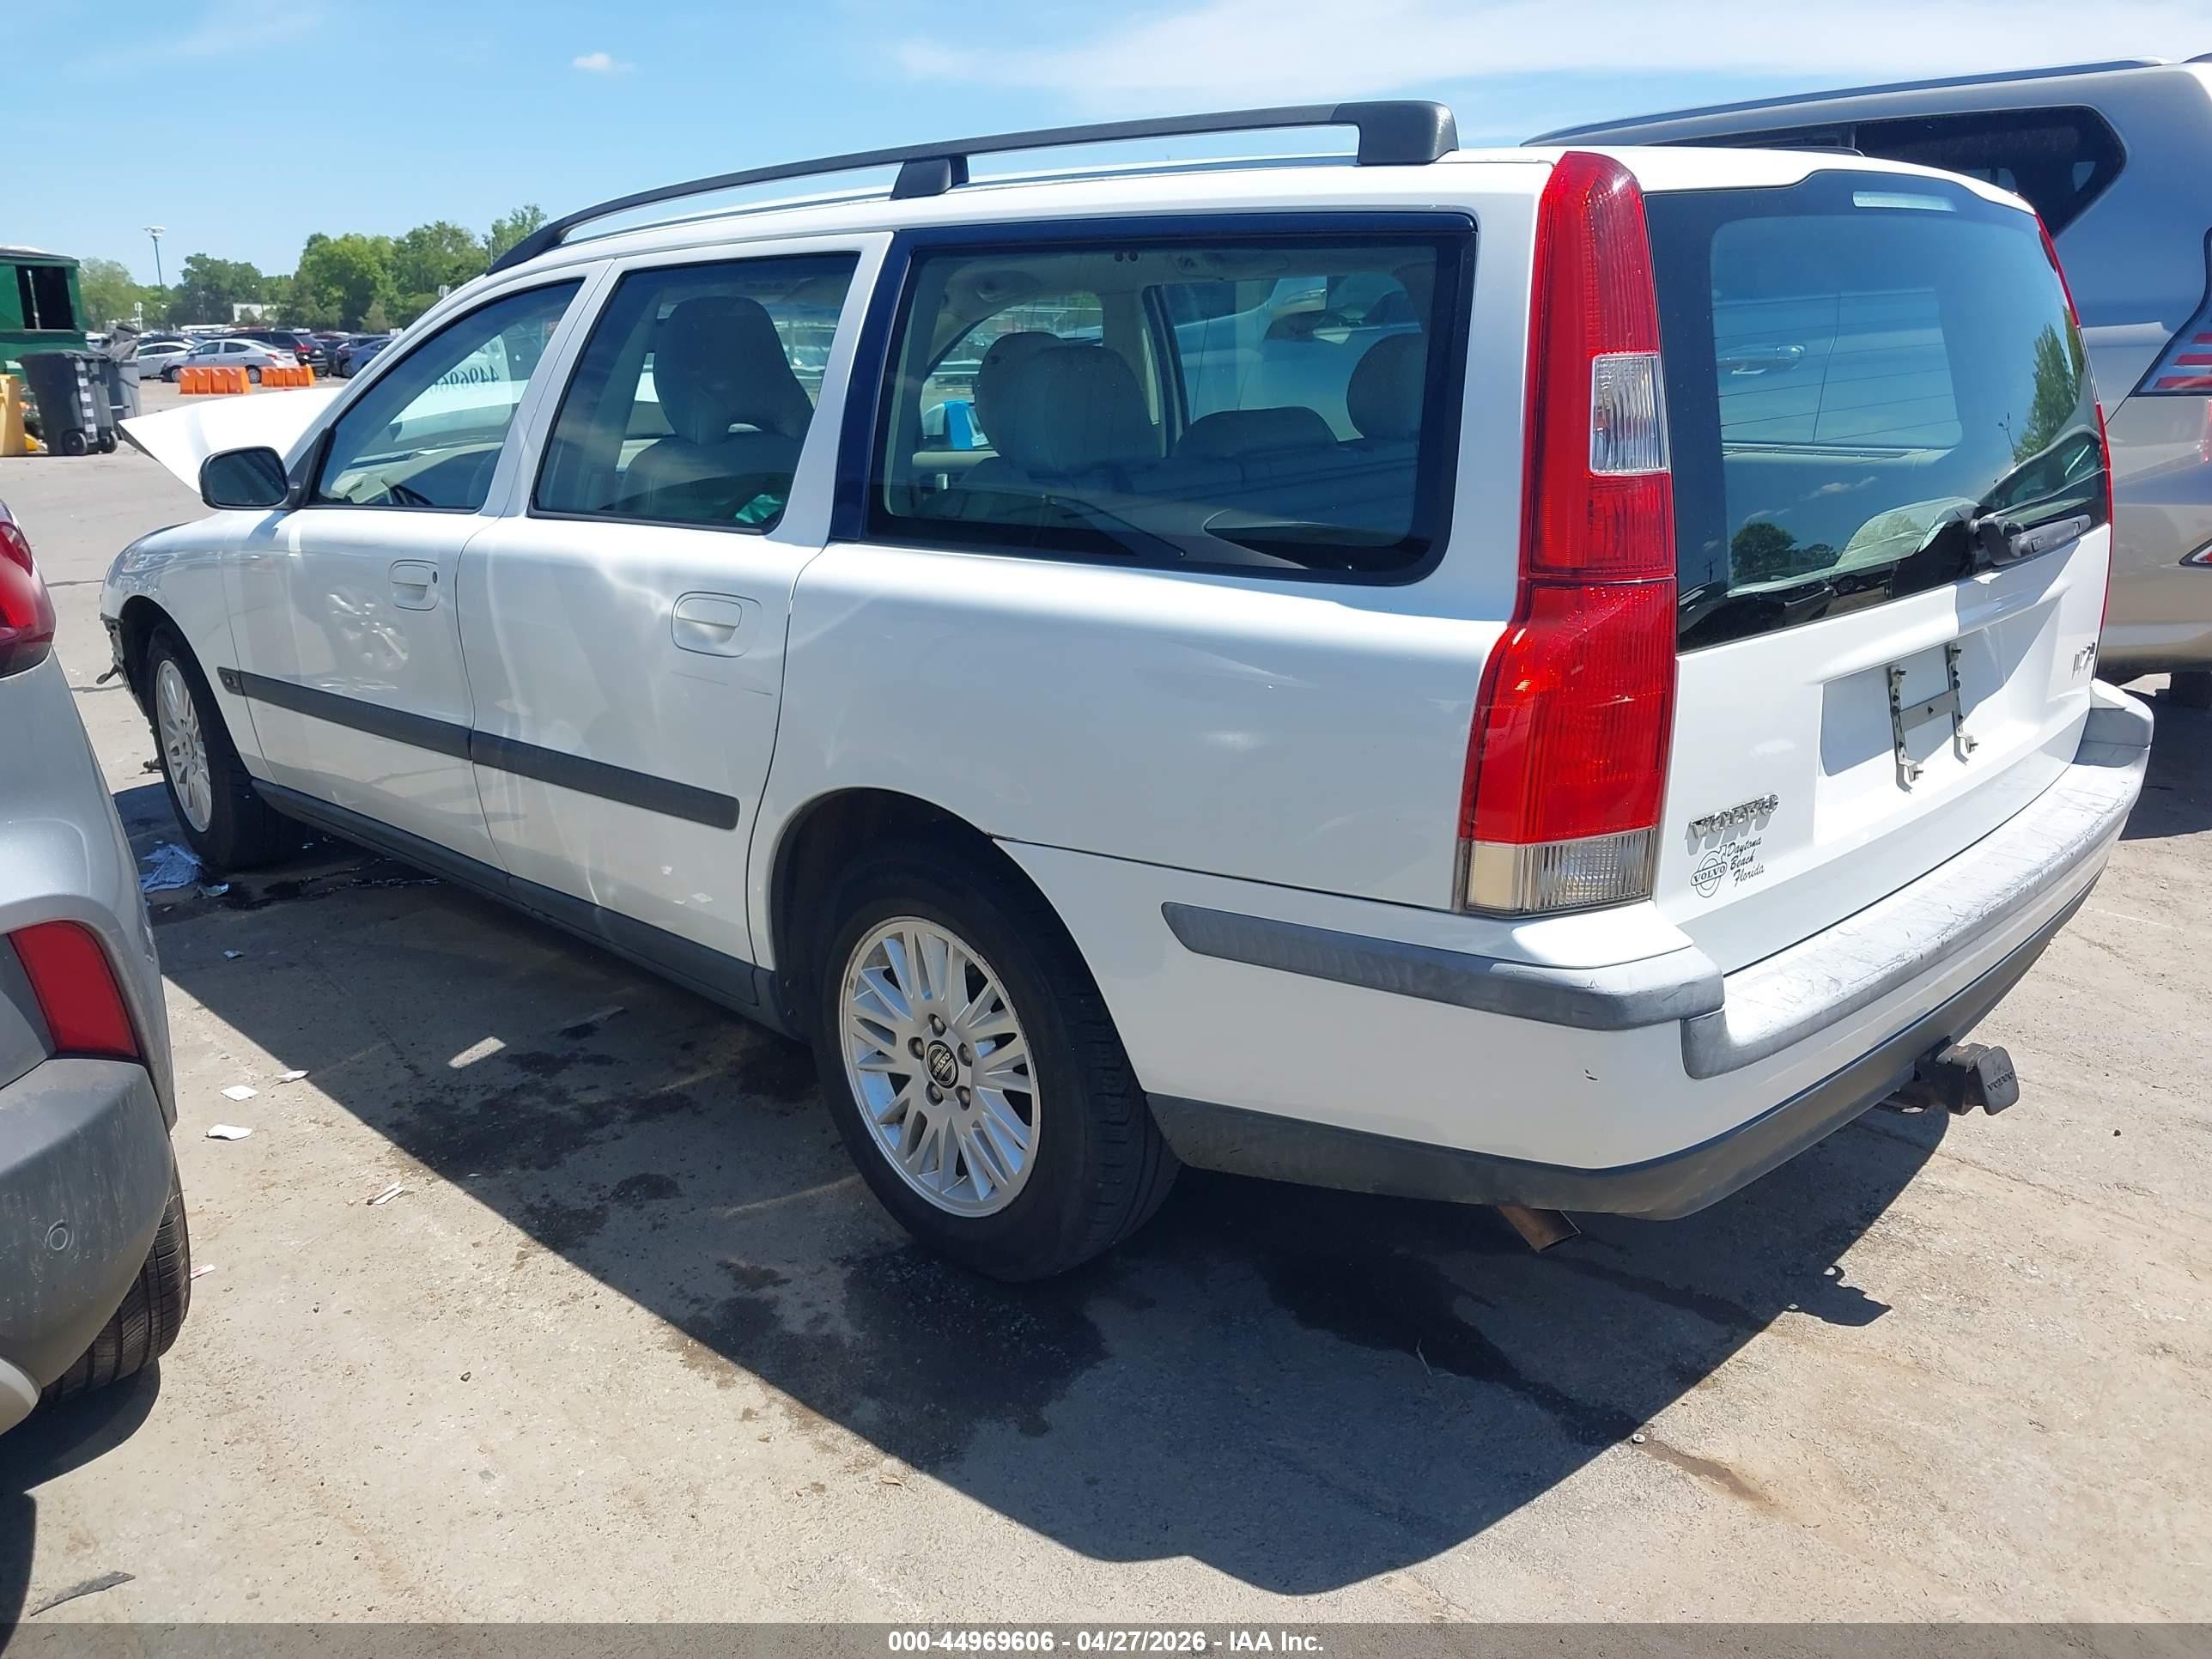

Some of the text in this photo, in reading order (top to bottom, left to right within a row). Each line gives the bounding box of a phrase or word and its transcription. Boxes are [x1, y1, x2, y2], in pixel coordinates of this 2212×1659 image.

[1726, 836, 1763, 858] Daytona
[1729, 848, 1755, 871] Beach
[1693, 865, 1726, 883] VOLVO
[1733, 863, 1765, 888] Florida
[933, 1053, 951, 1076] VOLVO
